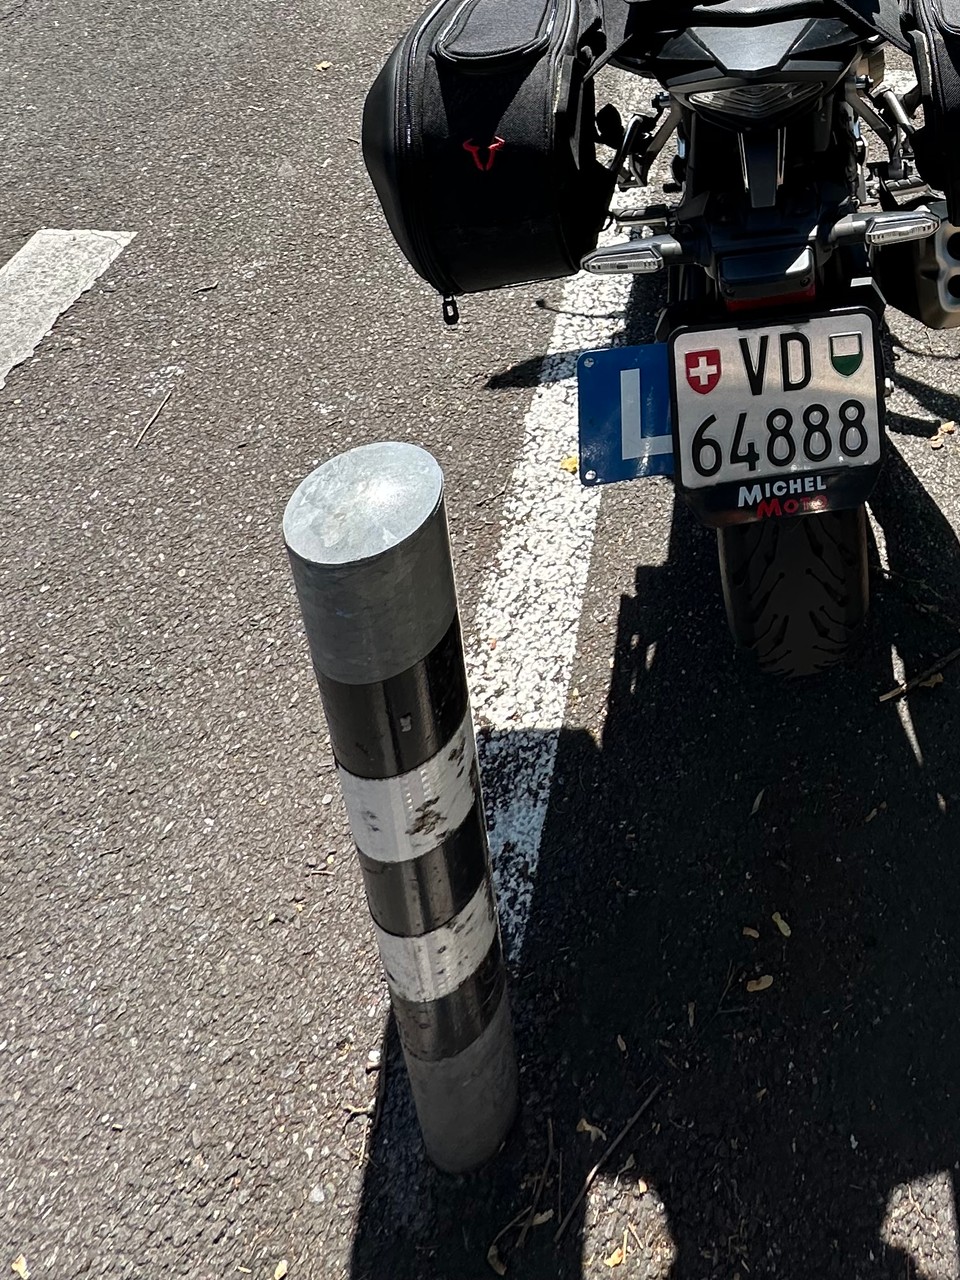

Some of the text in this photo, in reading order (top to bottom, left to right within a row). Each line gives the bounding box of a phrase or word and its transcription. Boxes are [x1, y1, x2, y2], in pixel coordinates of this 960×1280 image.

[738, 332, 812, 396] VD
[620, 368, 674, 460] L
[692, 399, 868, 477] 64888
[738, 476, 826, 507] MICHEL
[757, 495, 828, 519] MOTO
